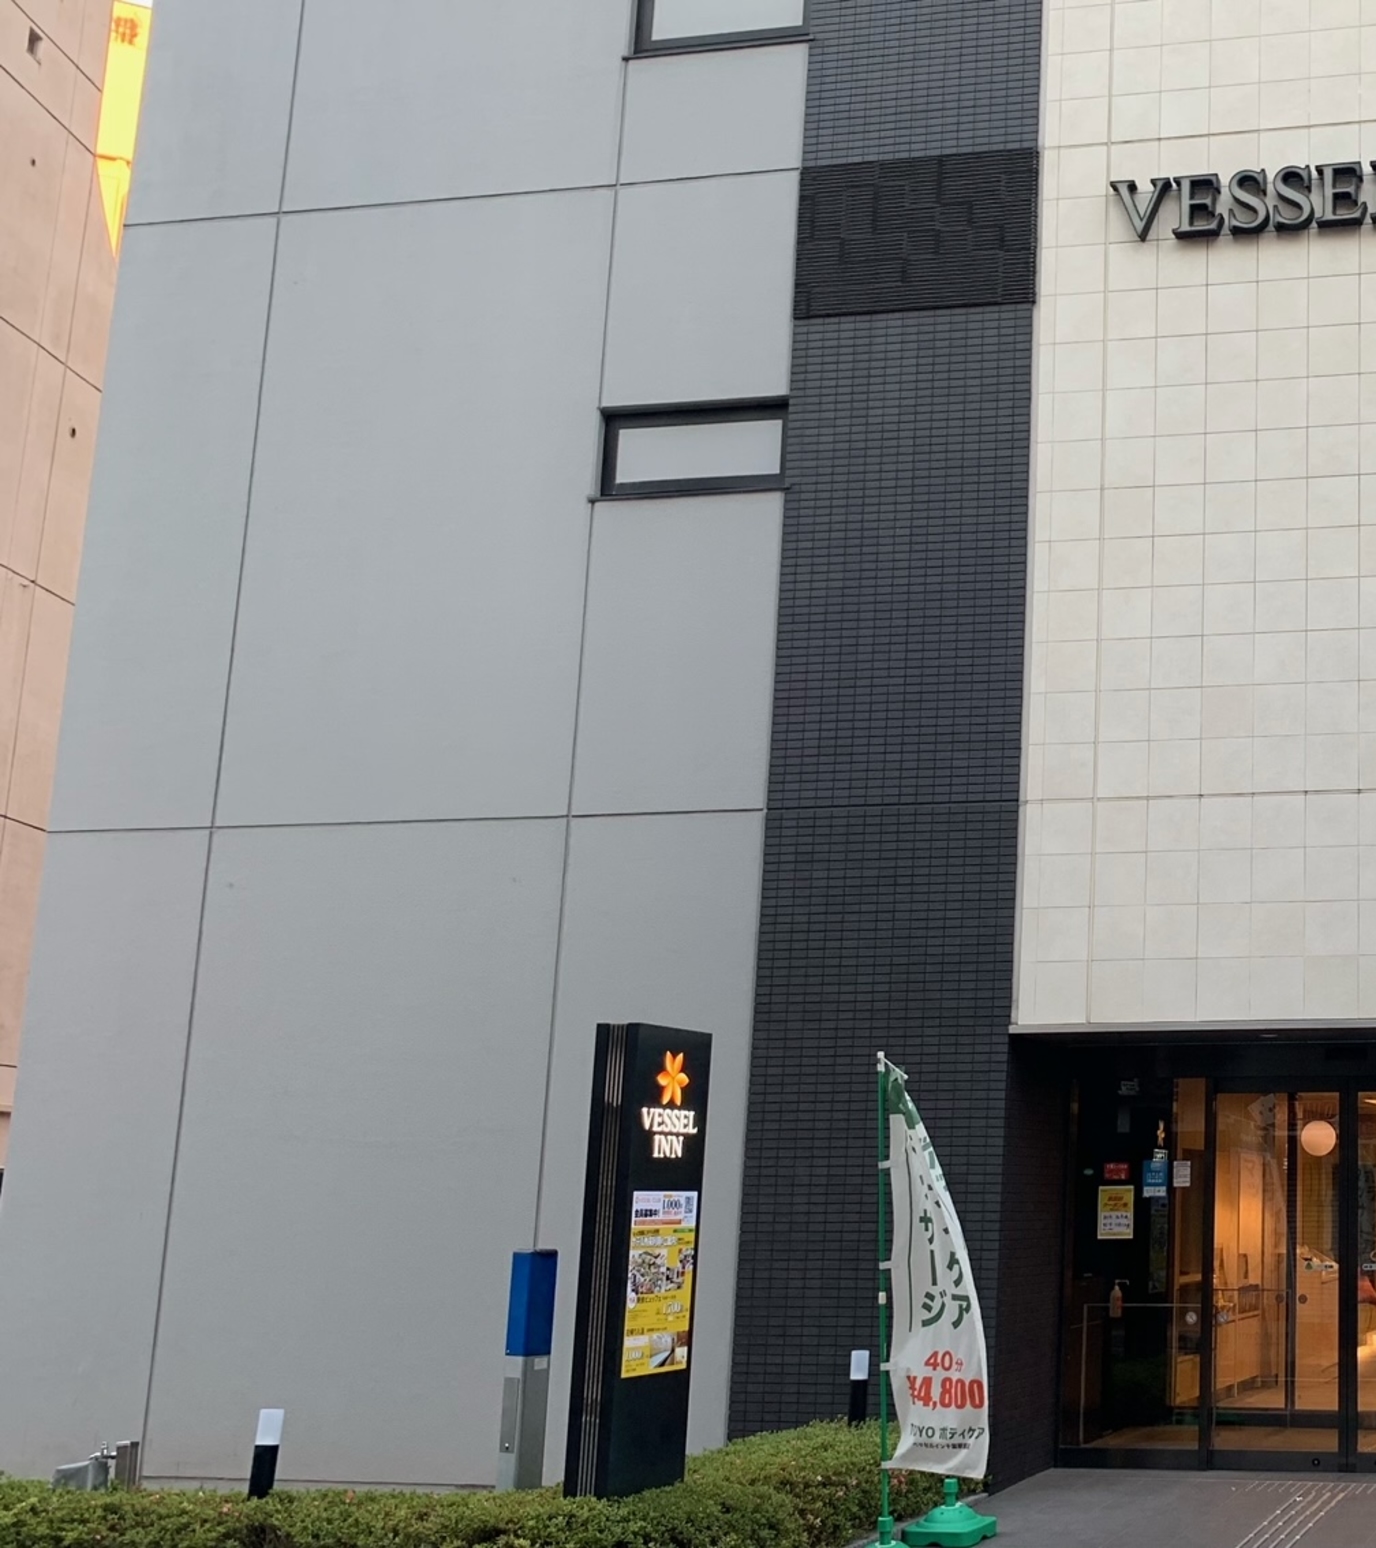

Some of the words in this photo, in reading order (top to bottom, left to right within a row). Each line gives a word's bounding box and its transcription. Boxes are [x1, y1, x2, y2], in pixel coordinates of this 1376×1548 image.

[641, 1106, 699, 1134] VESSEL
[652, 1134, 684, 1158] INN
[924, 1350, 964, 1373] 40分
[906, 1375, 985, 1411] ¥4,800
